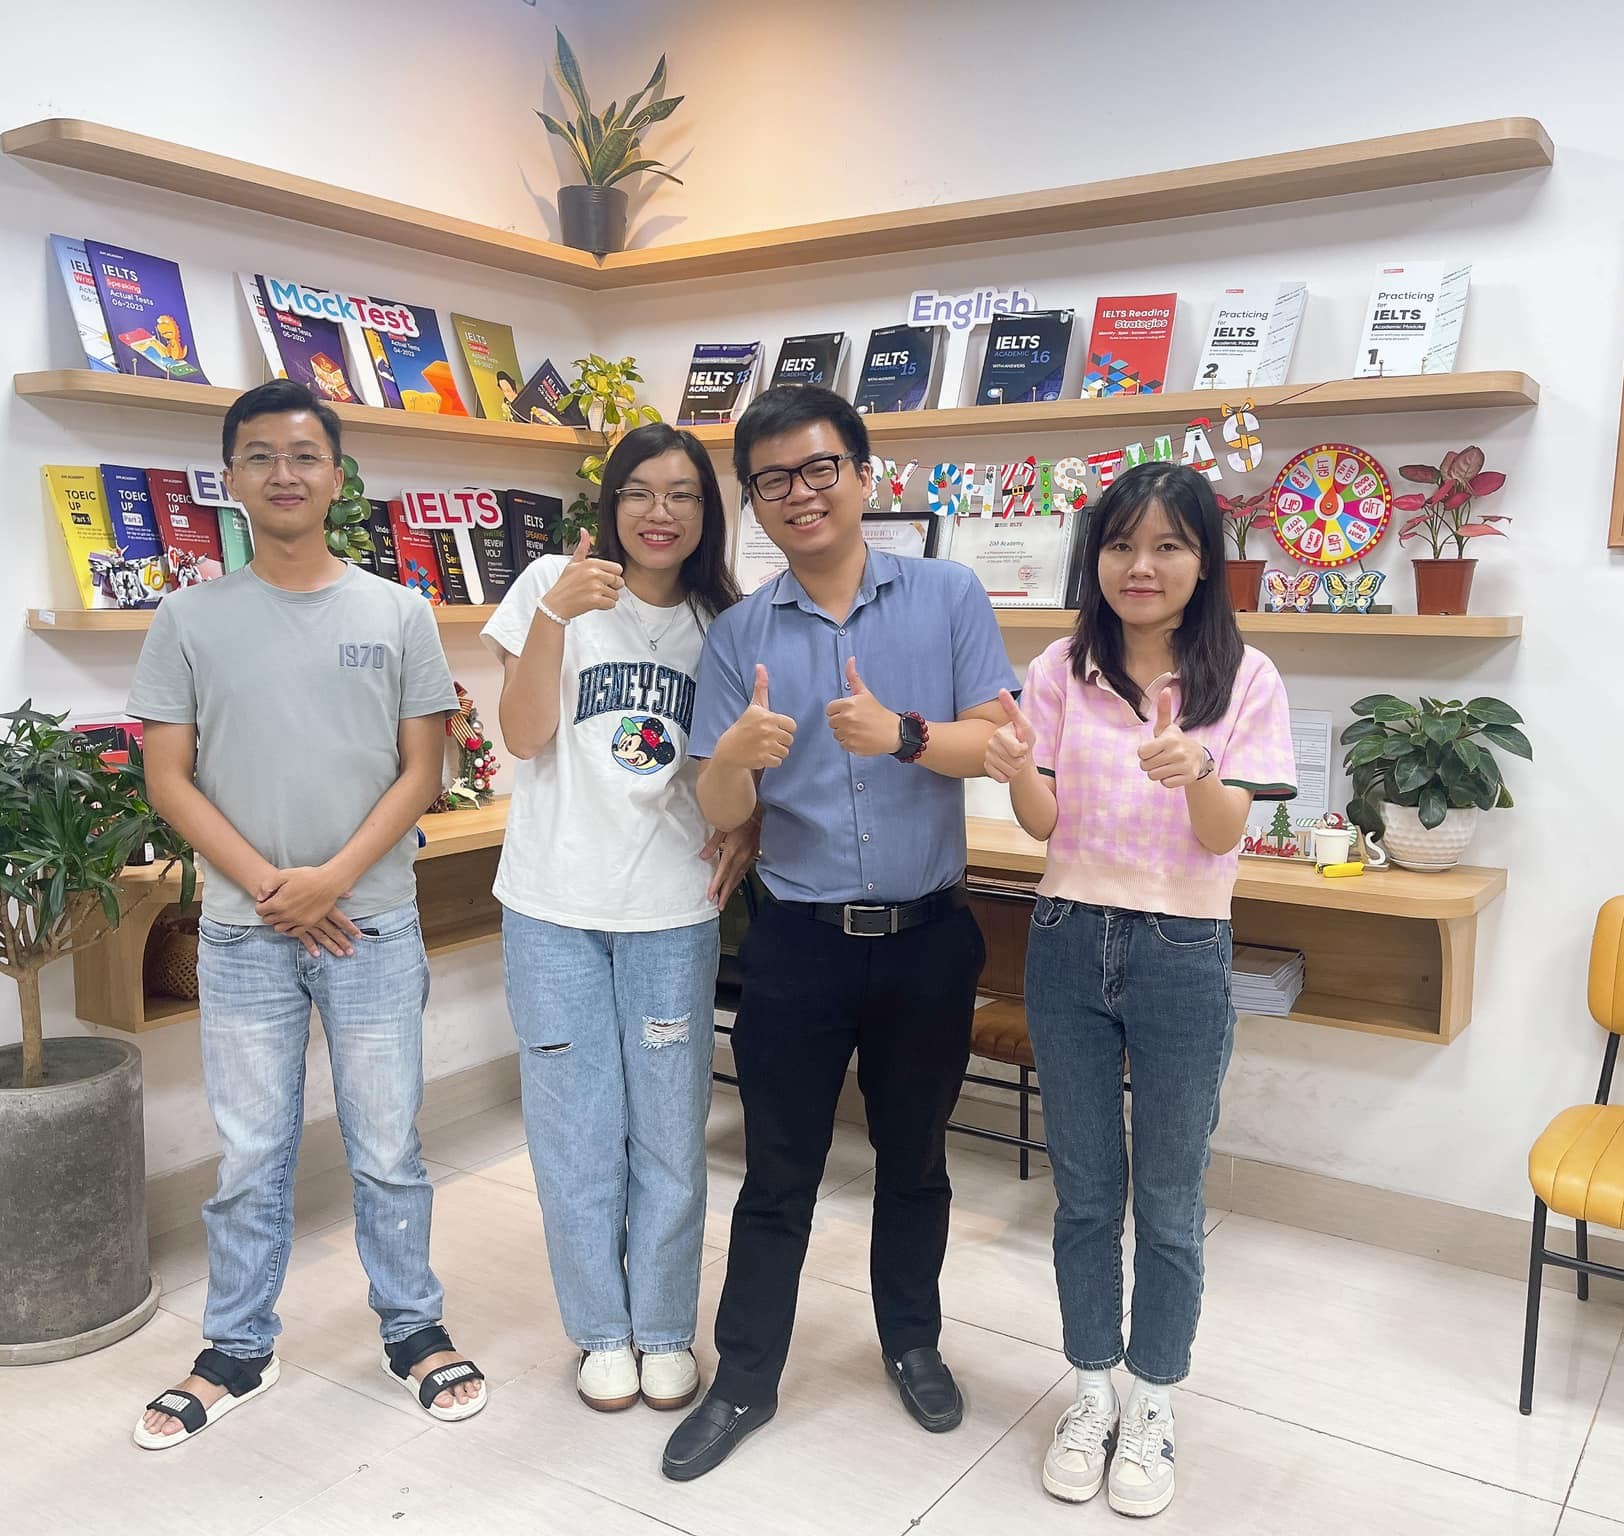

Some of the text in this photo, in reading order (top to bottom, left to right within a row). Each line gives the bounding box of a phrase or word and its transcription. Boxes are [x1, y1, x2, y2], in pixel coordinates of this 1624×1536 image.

[71, 259, 91, 274] IEL
[102, 263, 138, 281] IELTS
[106, 278, 141, 294] Speaking
[110, 289, 154, 306] Actual Tests
[112, 298, 144, 311] 06-2023
[1378, 292, 1435, 303] Practicing
[913, 291, 1030, 330] English
[1102, 308, 1170, 319] IELTS Reading
[1219, 310, 1269, 321] Practicing
[1374, 309, 1421, 321] IELTS
[1114, 319, 1168, 330] Strategies
[465, 331, 487, 345] IELTS
[1213, 327, 1256, 338] IELTS
[995, 335, 1040, 350] IELTS
[871, 351, 910, 367] IELTS
[1030, 350, 1051, 364] 16
[1368, 349, 1379, 365] 1
[781, 358, 816, 372] IELTS
[900, 362, 917, 376] 15
[1203, 363, 1219, 379] 2
[690, 369, 751, 385] IELTS 13
[808, 371, 823, 383] 14
[1316, 459, 1330, 477] GIFT
[1354, 475, 1370, 490] GOOD
[1357, 480, 1377, 496] LUCK!
[65, 490, 96, 501] TOEIC
[118, 490, 148, 502] TOEIC
[166, 493, 192, 504] TOEIC
[69, 502, 80, 511] UP
[121, 502, 134, 511] UP
[168, 504, 180, 513] UP
[406, 492, 499, 524] IELTS
[1281, 498, 1301, 512] GIFT
[1362, 500, 1381, 515] GIFT
[72, 514, 85, 523] Part
[125, 514, 136, 523] Part
[172, 517, 183, 525] Part
[524, 514, 544, 529] IELTS
[525, 530, 548, 542] SPEAKING
[1328, 534, 1341, 552] GIFT
[484, 539, 504, 548] REVIEW
[526, 540, 544, 550] REVIEW
[339, 643, 385, 669] 1970
[432, 1364, 475, 1386] PUMA
